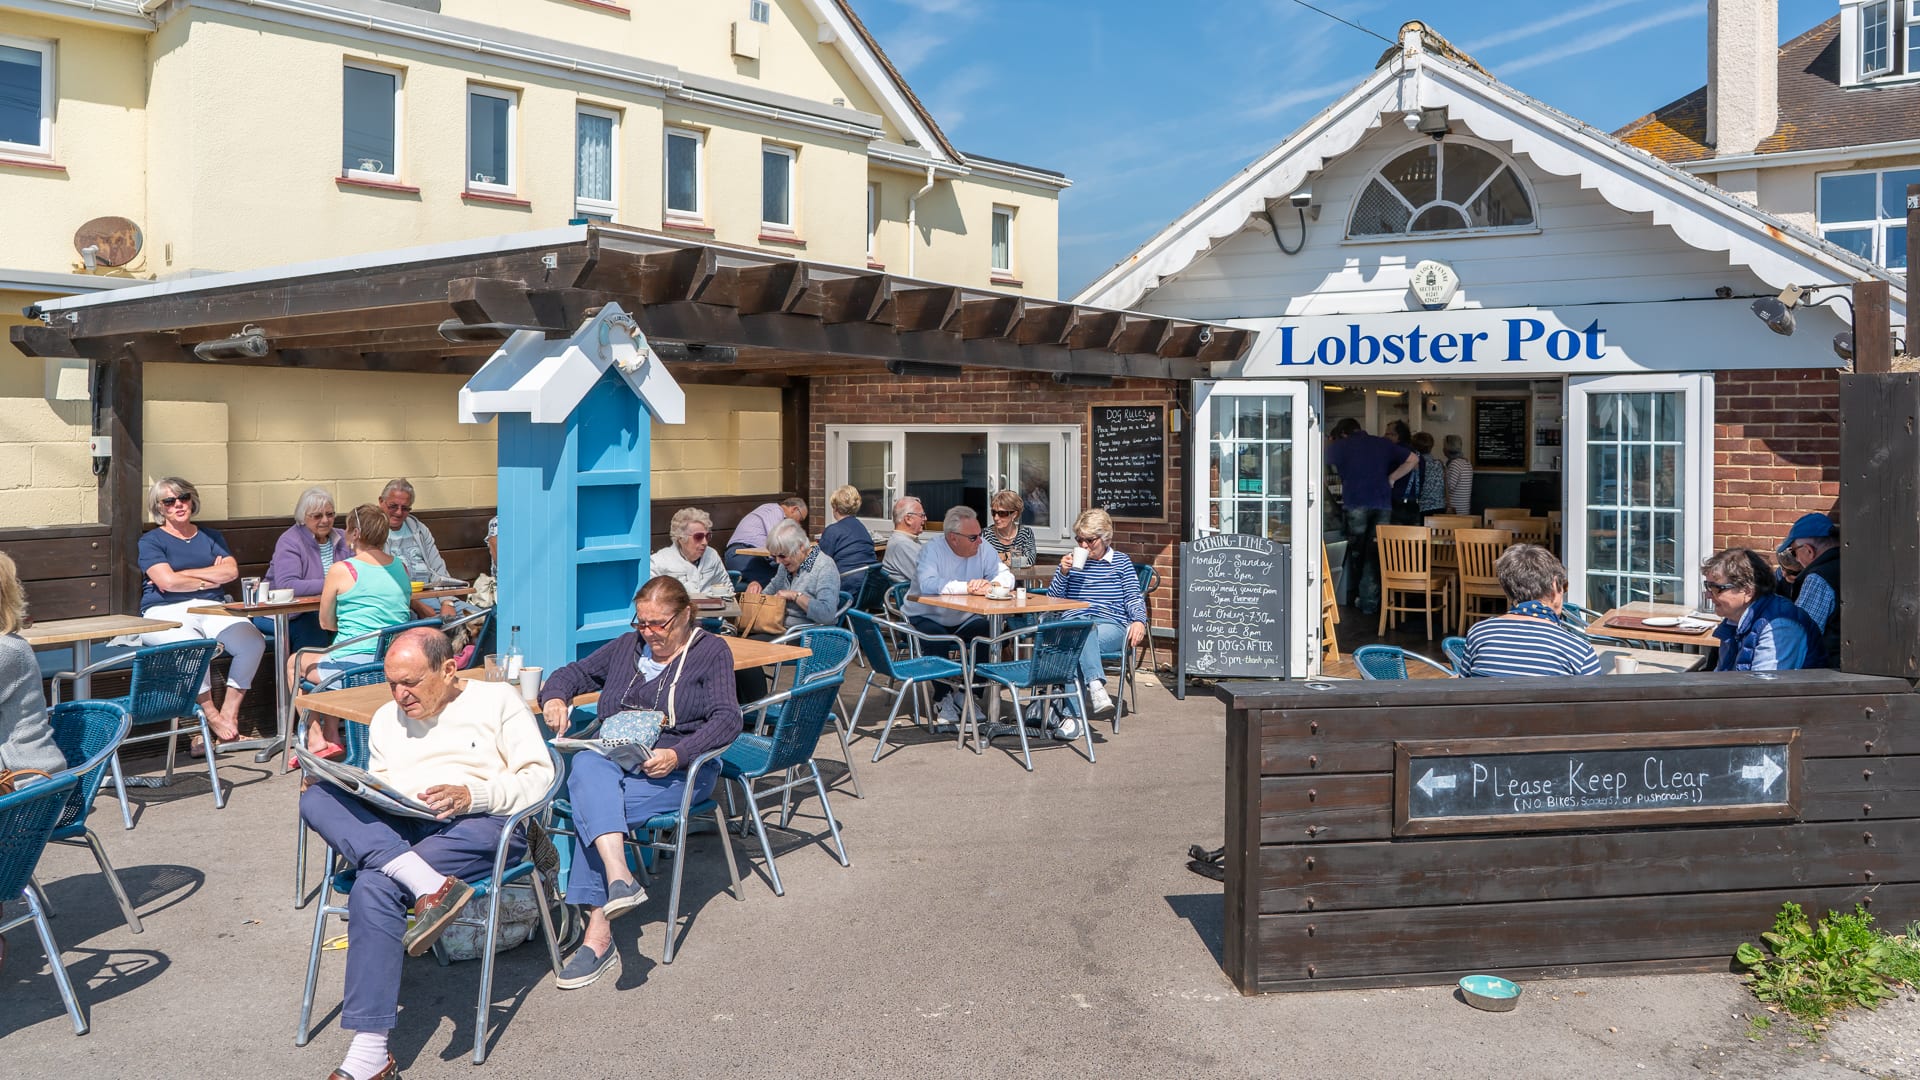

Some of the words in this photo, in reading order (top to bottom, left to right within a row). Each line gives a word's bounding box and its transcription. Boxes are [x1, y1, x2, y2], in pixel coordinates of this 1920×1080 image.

[1275, 324, 1488, 366] Lobster
[1501, 318, 1607, 363] Pot
[1106, 409, 1122, 420] DOG
[1192, 553, 1227, 571] Monday
[1234, 554, 1274, 575] Sunday
[1189, 583, 1219, 596] Evening
[1193, 608, 1211, 618] Last
[1192, 623, 1204, 632] We
[1206, 624, 1225, 634] close
[1242, 627, 1261, 637] 8pm
[1197, 640, 1214, 651] NO
[1217, 640, 1246, 651] DOGS
[1246, 640, 1273, 652] AFTER
[1473, 762, 1552, 798] Please
[1569, 759, 1627, 799] Keep
[1643, 756, 1709, 790] Clear
[1623, 796, 1632, 804] or
